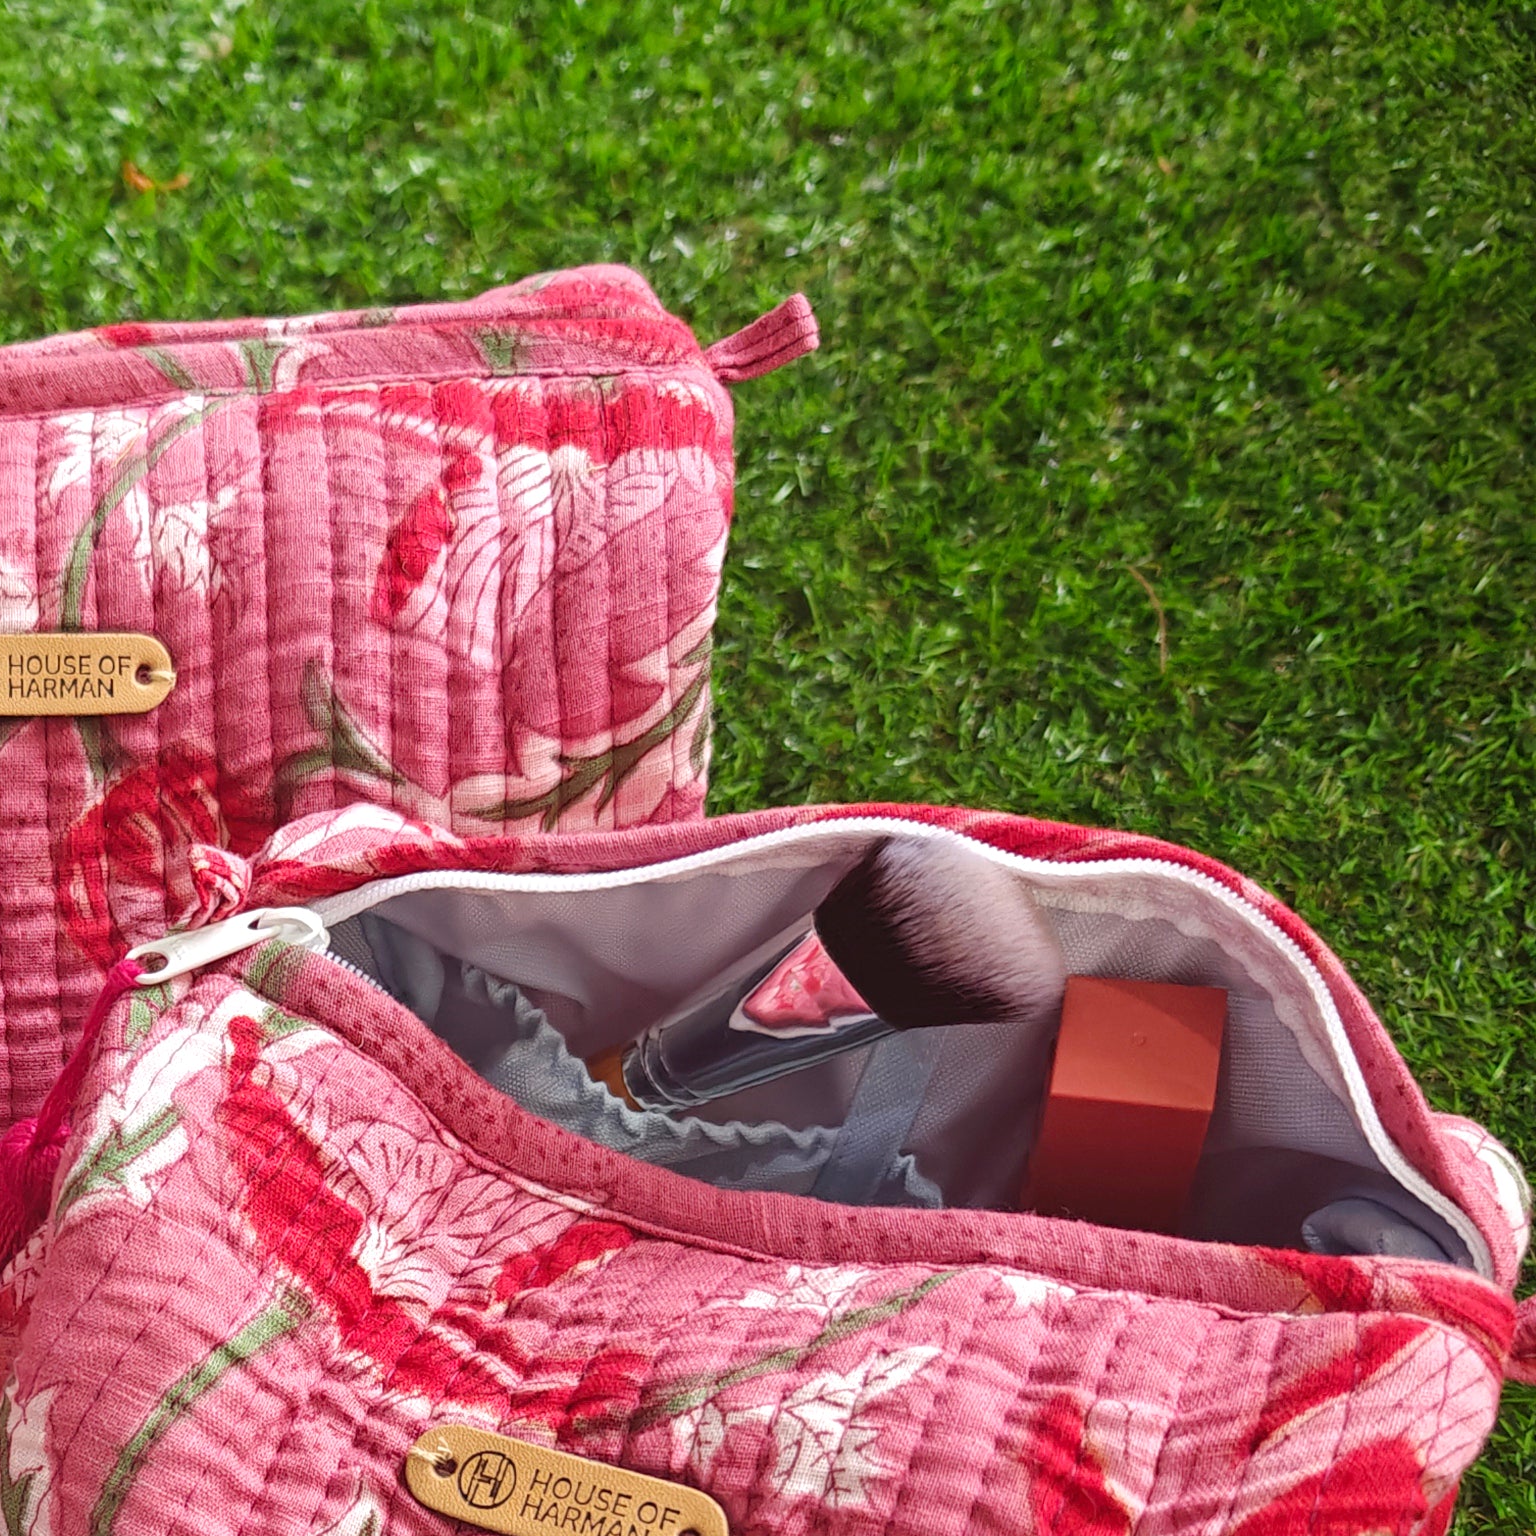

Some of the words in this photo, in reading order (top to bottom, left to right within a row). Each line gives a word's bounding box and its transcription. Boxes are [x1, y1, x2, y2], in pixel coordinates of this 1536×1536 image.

[8, 655, 91, 676] HOUSE
[98, 655, 132, 676] OF
[8, 678, 114, 699] HARMAN
[529, 1468, 632, 1517] HOUSE
[638, 1501, 681, 1530] OF
